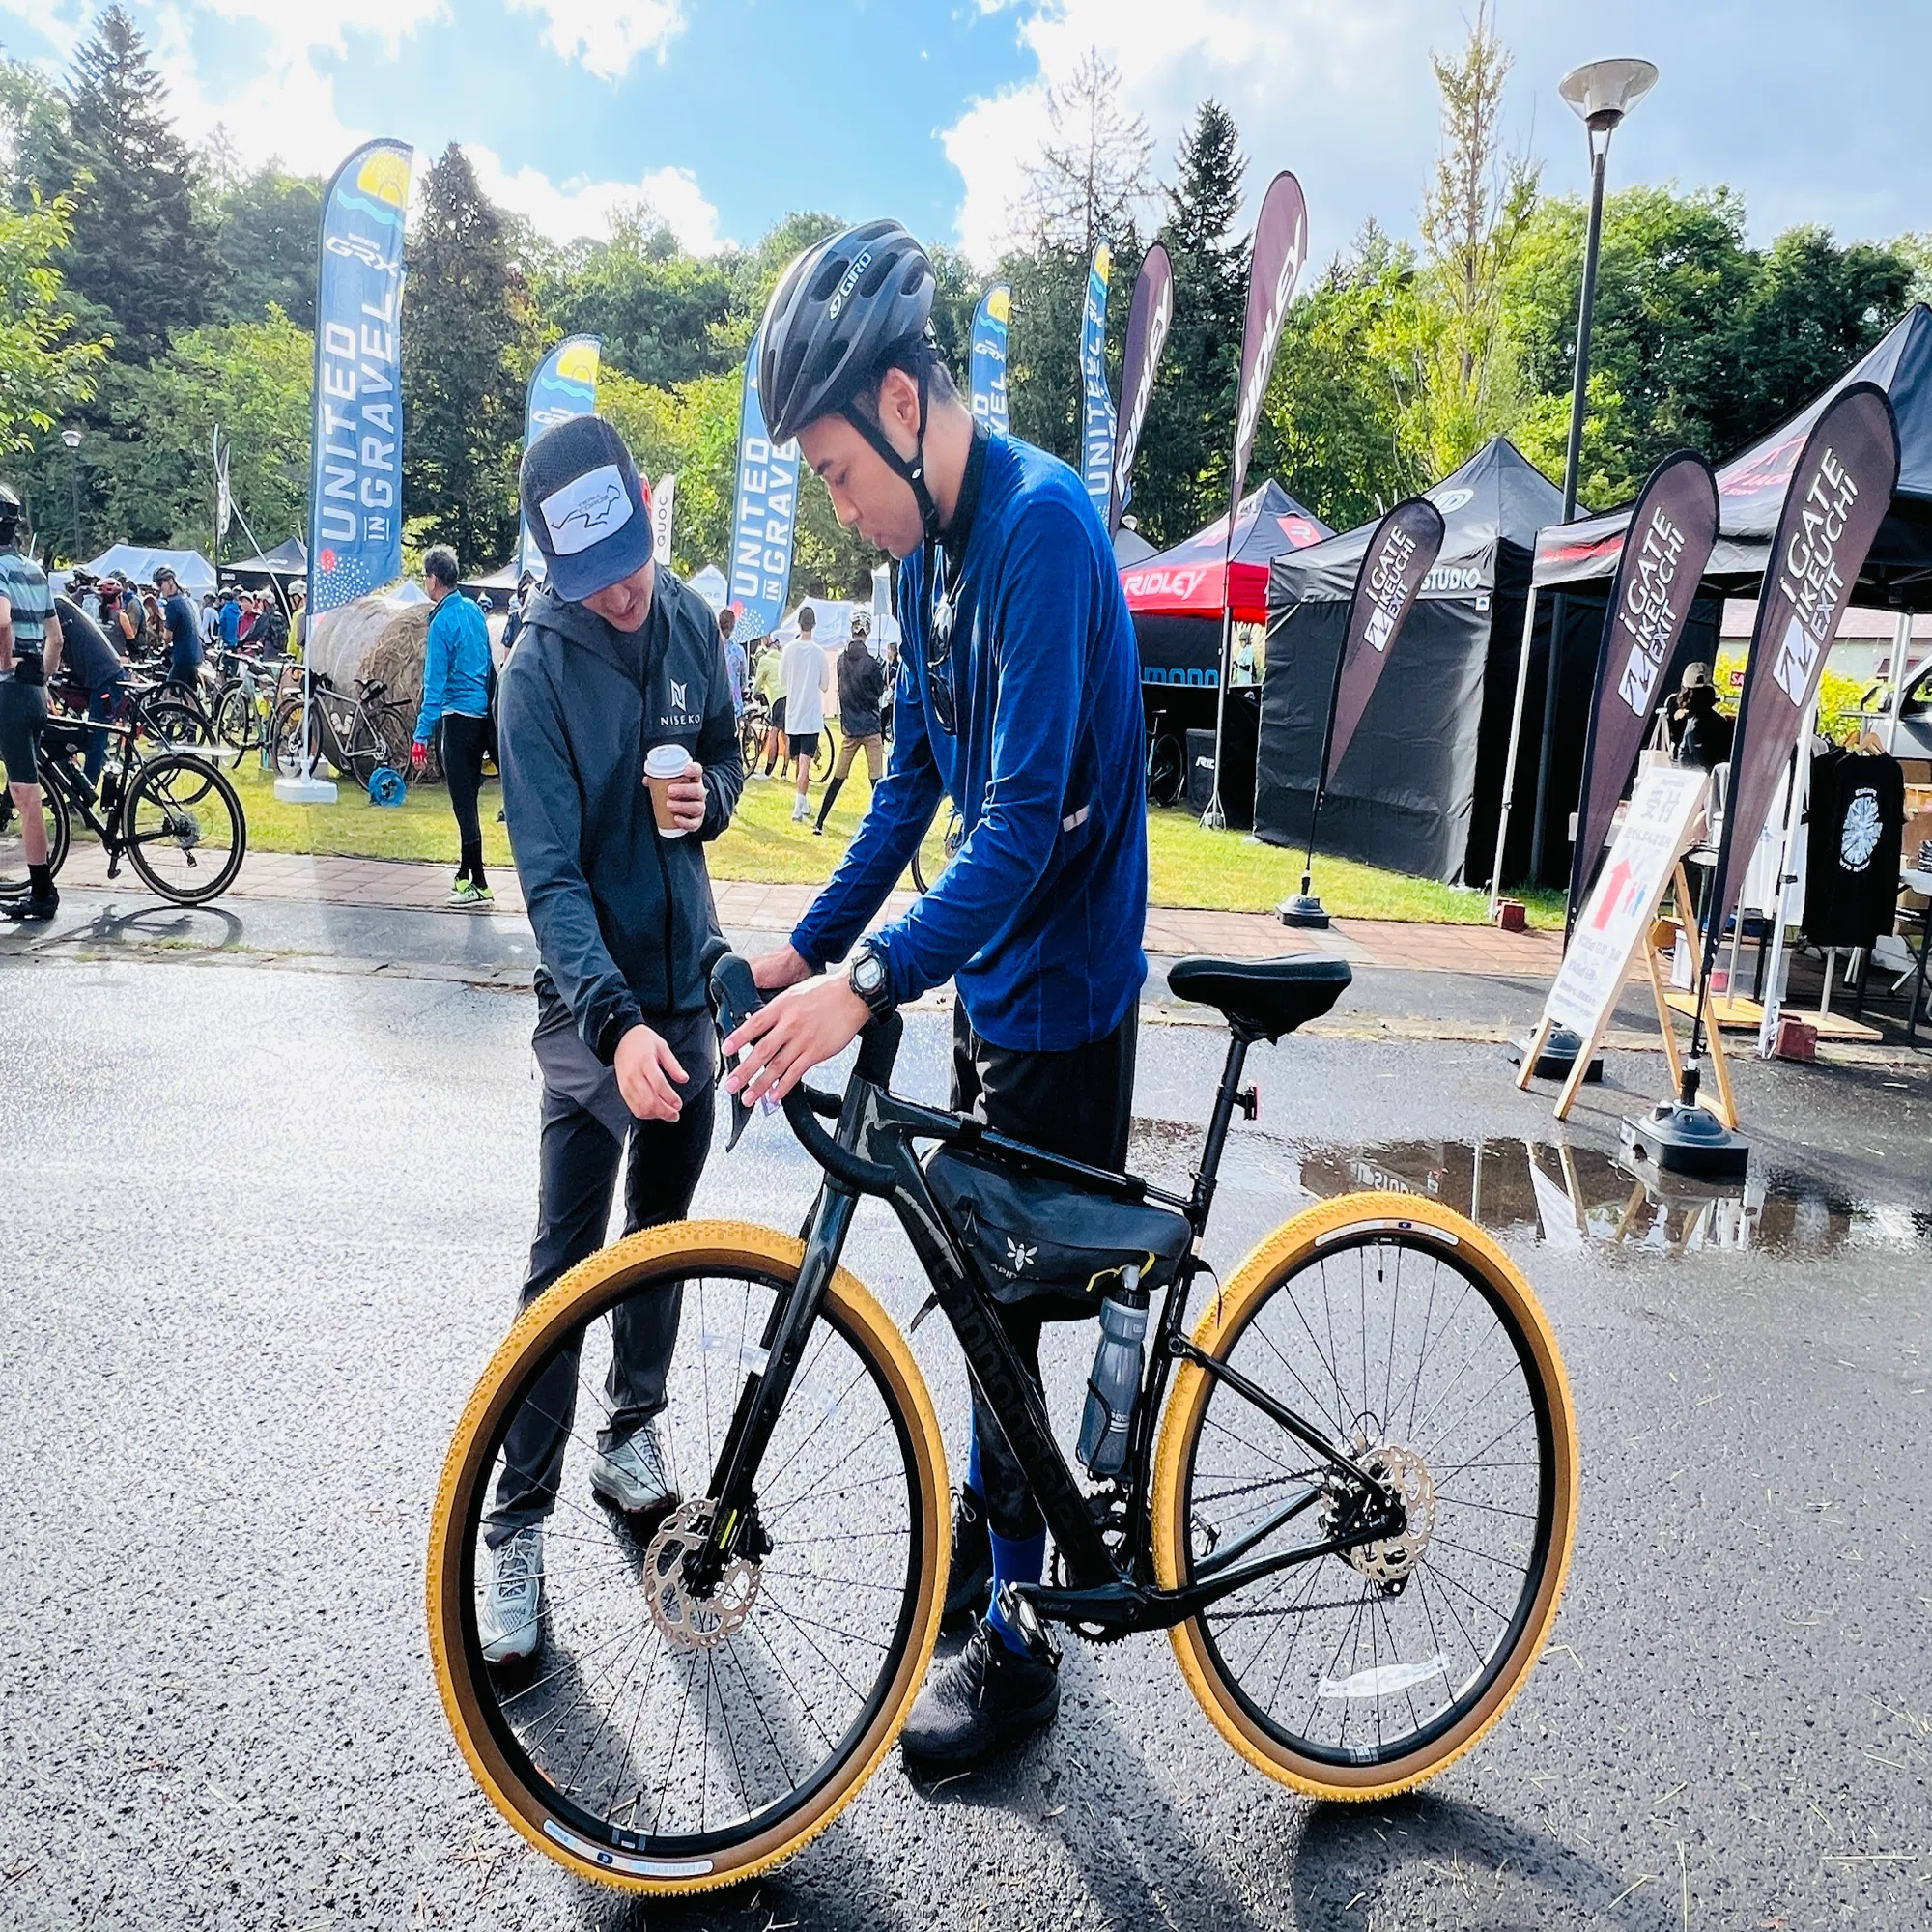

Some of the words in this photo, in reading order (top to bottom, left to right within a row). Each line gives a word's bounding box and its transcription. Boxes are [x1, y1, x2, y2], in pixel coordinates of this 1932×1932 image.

[325, 236, 400, 278] GRX
[839, 251, 872, 297] GIRO
[360, 293, 395, 510] GRAVEL
[989, 371, 1007, 435] VEL
[321, 320, 357, 543] UNITED
[364, 517, 389, 543] IN
[657, 496, 668, 547] QUOC
[734, 437, 770, 598] UNITED
[761, 436, 796, 576] GRAVE
[1378, 538, 1417, 611] IKEUCHI
[1794, 476, 1859, 623] IKEUCHI
[762, 580, 784, 601] IN
[1124, 570, 1207, 601] RIDLEY
[1386, 579, 1409, 620] EXIT
[1420, 567, 1481, 592] STUDIO
[1635, 527, 1685, 650] IKEUCHI
[1809, 561, 1844, 643] EXIT
[1648, 609, 1677, 666] EXIT
[660, 715, 701, 726] NISEKO
[1640, 789, 1682, 824] 受付
